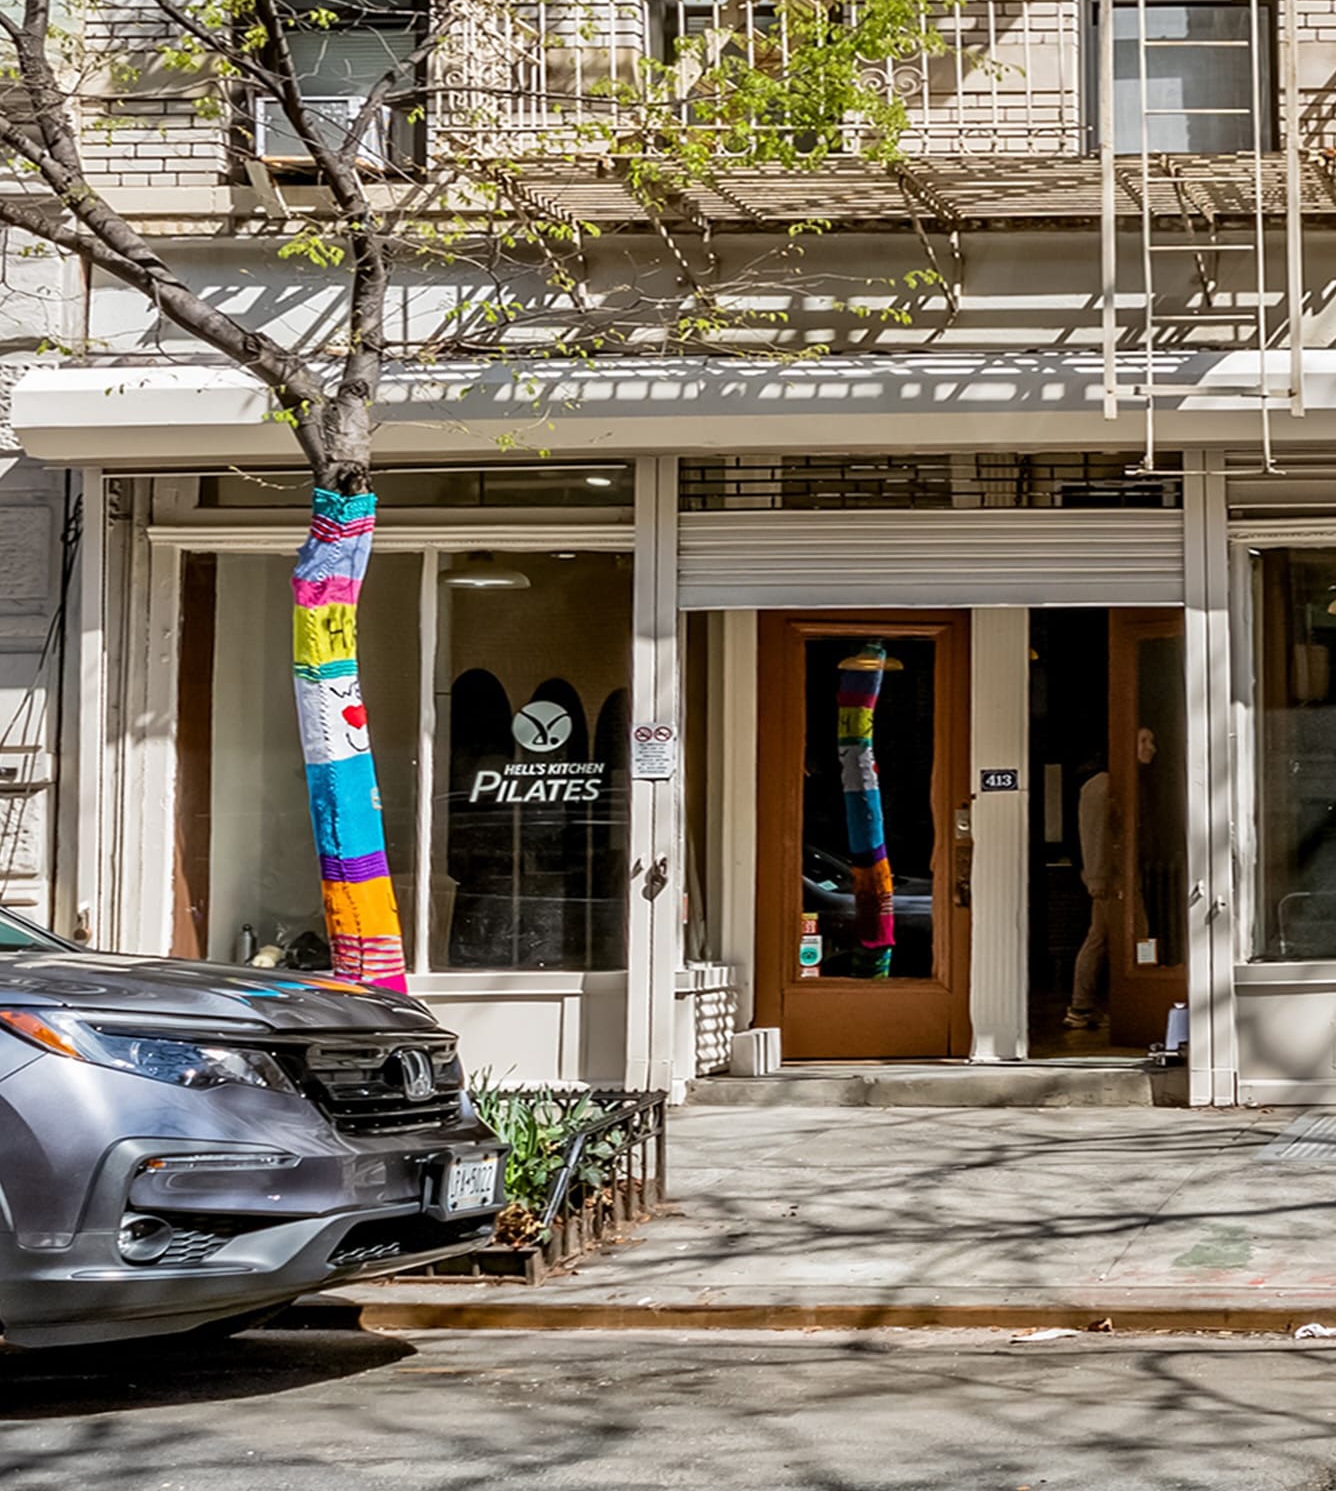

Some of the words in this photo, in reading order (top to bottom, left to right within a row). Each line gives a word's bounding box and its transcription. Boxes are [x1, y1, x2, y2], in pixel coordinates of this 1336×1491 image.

[504, 763, 547, 776] HELL'S
[547, 762, 605, 775] KITCHEN
[469, 770, 602, 803] PILATES
[985, 774, 1012, 787] 413
